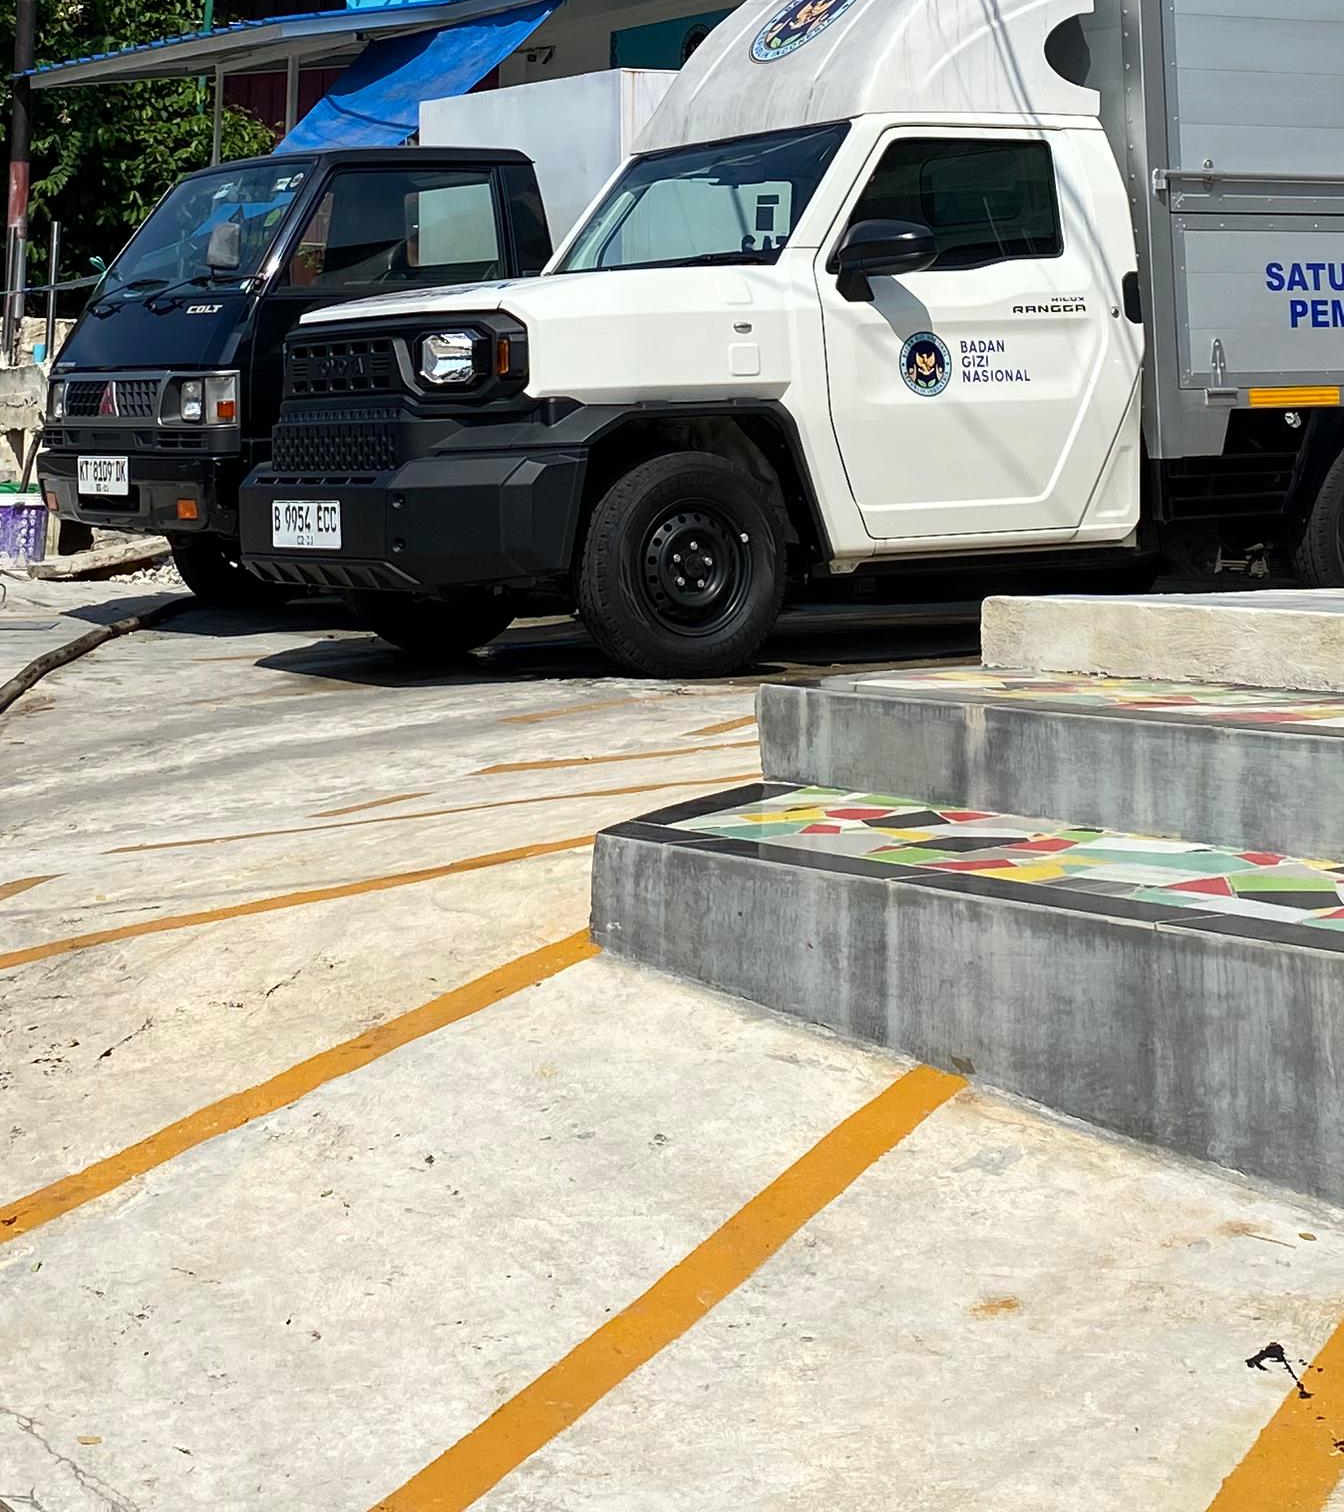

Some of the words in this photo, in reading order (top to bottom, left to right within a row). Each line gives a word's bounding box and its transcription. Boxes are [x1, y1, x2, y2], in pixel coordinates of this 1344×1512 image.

[186, 304, 223, 315] COLT
[1012, 304, 1087, 315] RANGGA
[960, 339, 1005, 354] BADAN
[961, 355, 989, 368] GIZI
[962, 369, 1031, 383] NASIONAL
[274, 505, 280, 531] B
[285, 504, 311, 532] 9954
[317, 504, 337, 533] ECC
